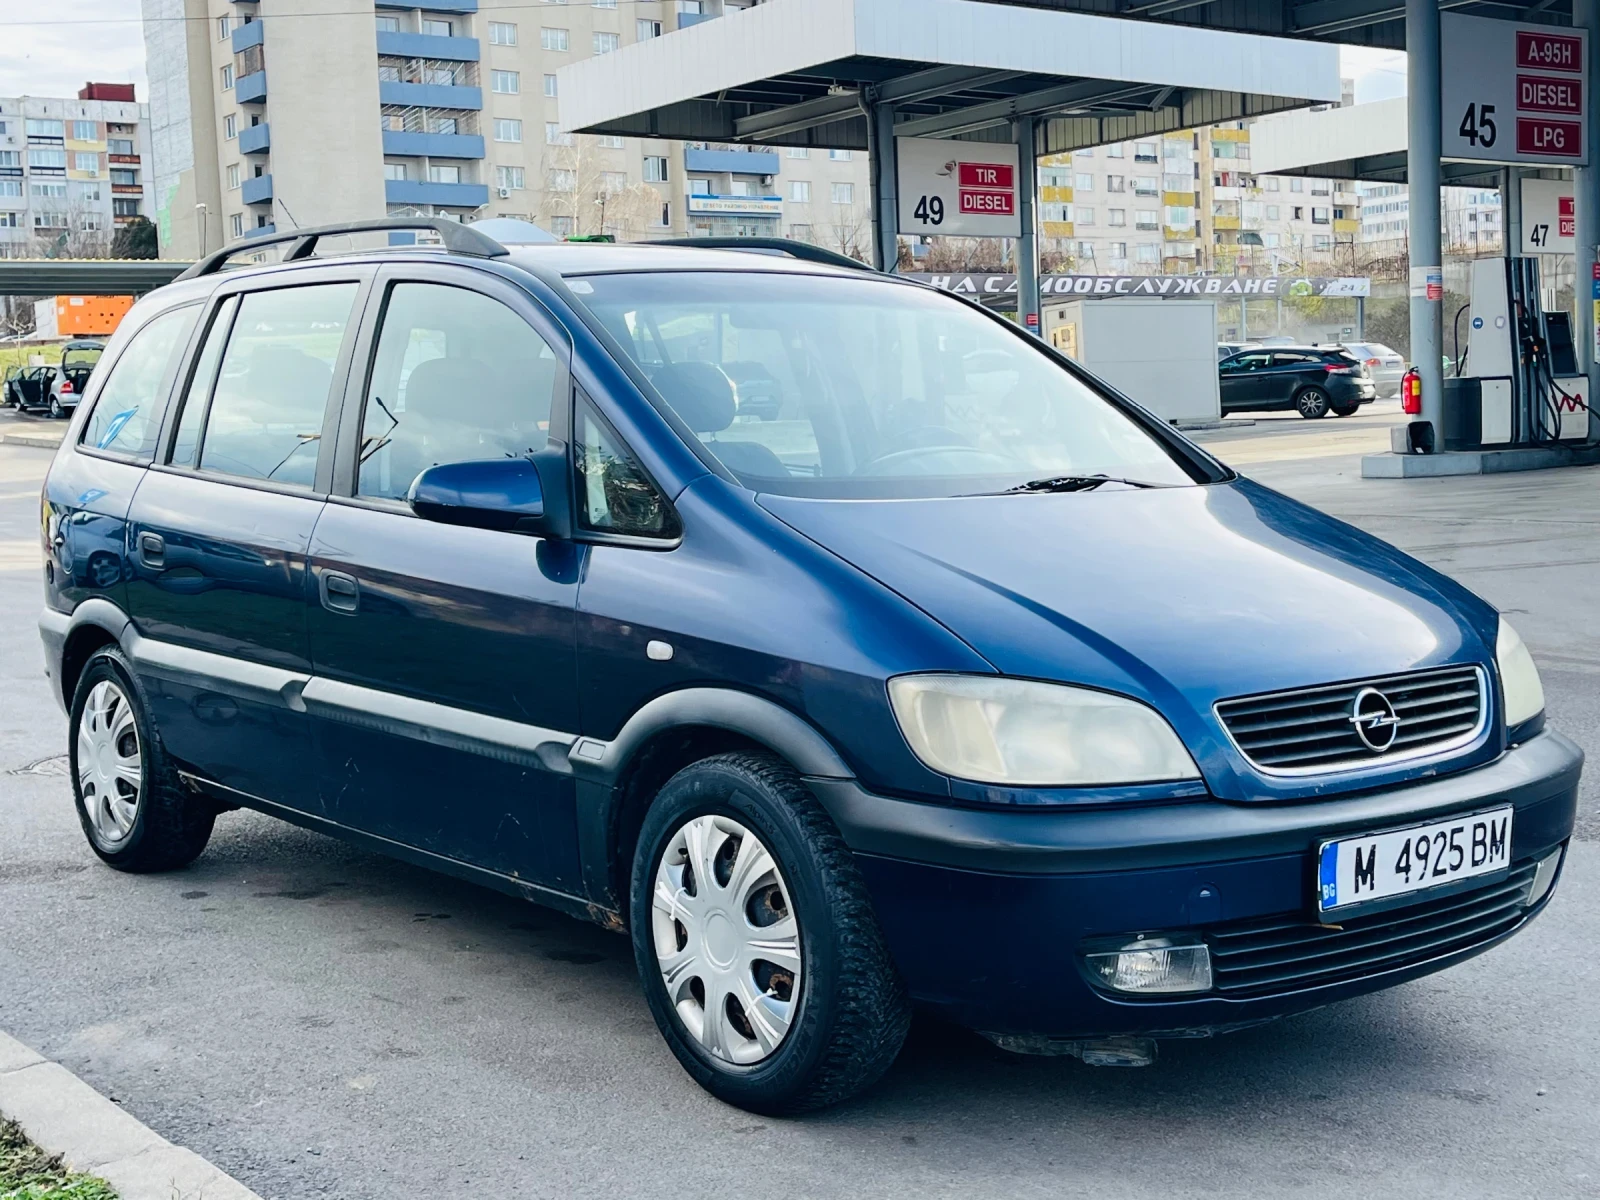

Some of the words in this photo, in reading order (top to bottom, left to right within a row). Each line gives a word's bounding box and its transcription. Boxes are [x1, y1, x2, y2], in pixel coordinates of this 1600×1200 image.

[1528, 41, 1571, 64] A-95H
[1522, 83, 1576, 107] DIESEL
[1459, 103, 1496, 148] 45
[1534, 127, 1565, 148] LPG
[976, 169, 997, 183] TIR
[914, 195, 944, 225] 49
[963, 194, 1010, 211] DIESEL
[1530, 224, 1549, 247] 47
[1561, 221, 1575, 233] DIE
[1354, 844, 1377, 893] M
[1322, 883, 1336, 900] BG
